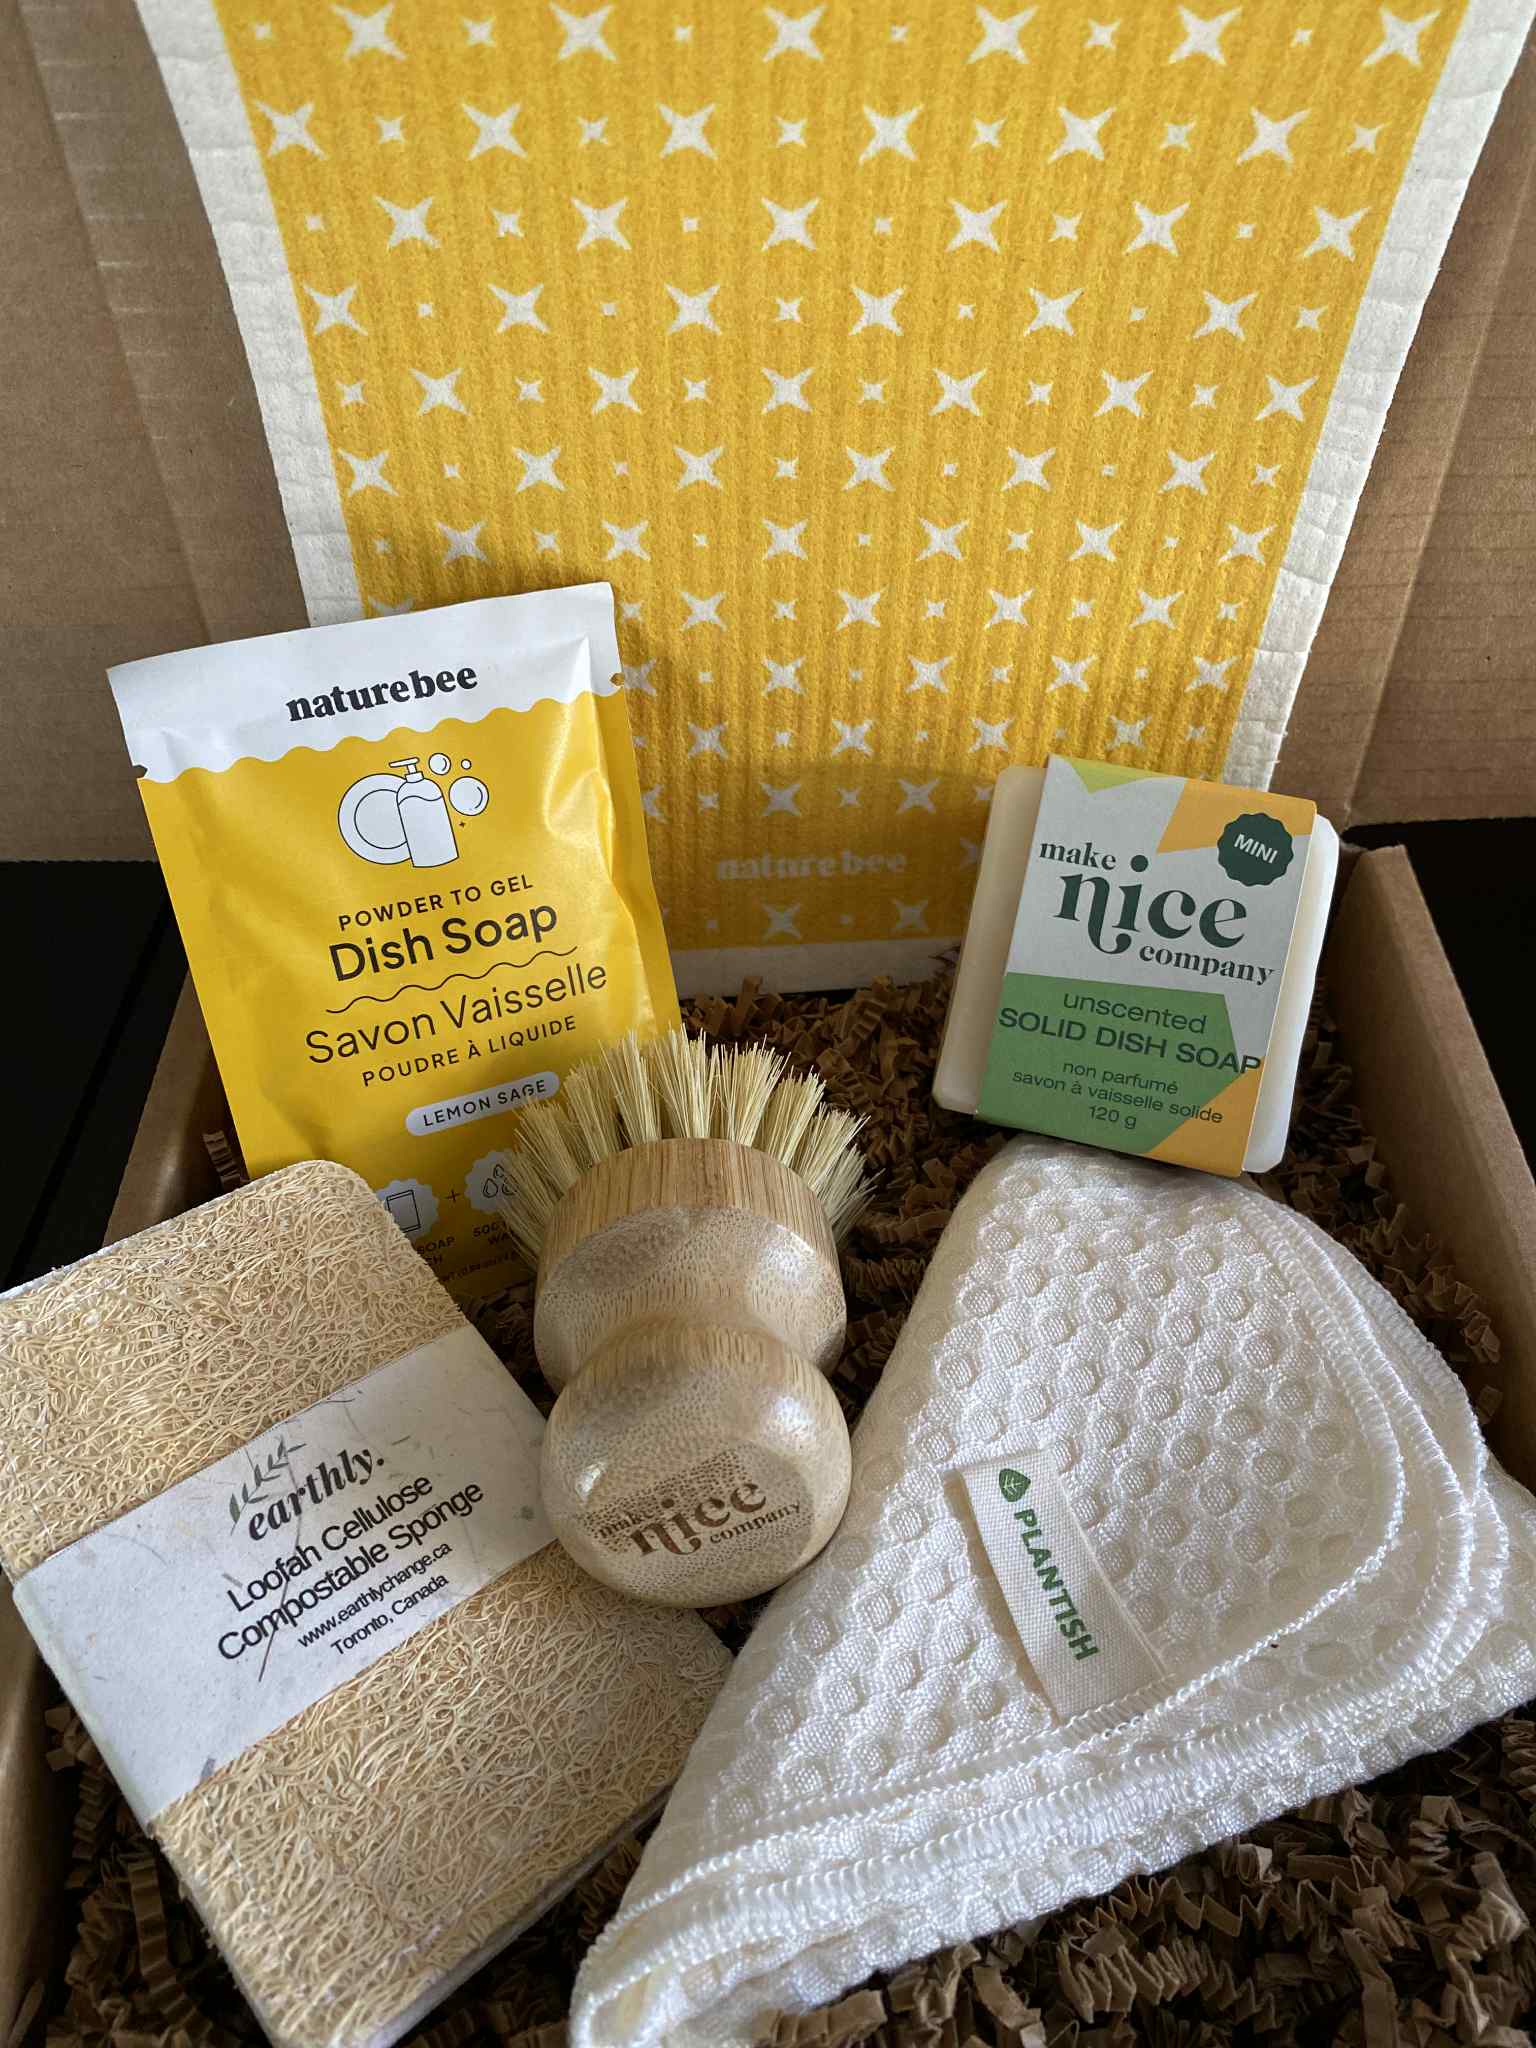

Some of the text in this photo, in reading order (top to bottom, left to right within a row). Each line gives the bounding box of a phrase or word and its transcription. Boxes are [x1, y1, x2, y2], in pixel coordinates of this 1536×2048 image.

[286, 667, 478, 722] naturebee
[1038, 841, 1117, 872] make
[1233, 834, 1279, 865] MINI
[338, 874, 534, 932] POWDER TO GEL
[1053, 854, 1247, 955] nice
[329, 904, 558, 982] Dish Soap
[1139, 942, 1279, 986] company
[305, 963, 608, 1064] Savon Vaisselle
[999, 1007, 1261, 1075] SOLID DISH SOAP
[1063, 993, 1207, 1035] unscented
[362, 1015, 578, 1087] POUDRE À LIQUIDE
[1062, 1061, 1179, 1096] non parfumé
[423, 1079, 547, 1127] LEMON SAGE
[1012, 1069, 1223, 1124] savon à vaisselle solide
[1088, 1105, 1138, 1130] 120 g
[248, 1447, 385, 1541] earthly.
[629, 1482, 767, 1556] nice
[709, 1500, 801, 1545] company
[218, 1483, 484, 1660] Compostable Sponge
[227, 1476, 433, 1613] Loofah Cellulose
[298, 1542, 453, 1648] www.earthlychange.ca
[330, 1572, 449, 1656] Toronto, Canada
[1013, 1508, 1100, 1661] PLANTISH
